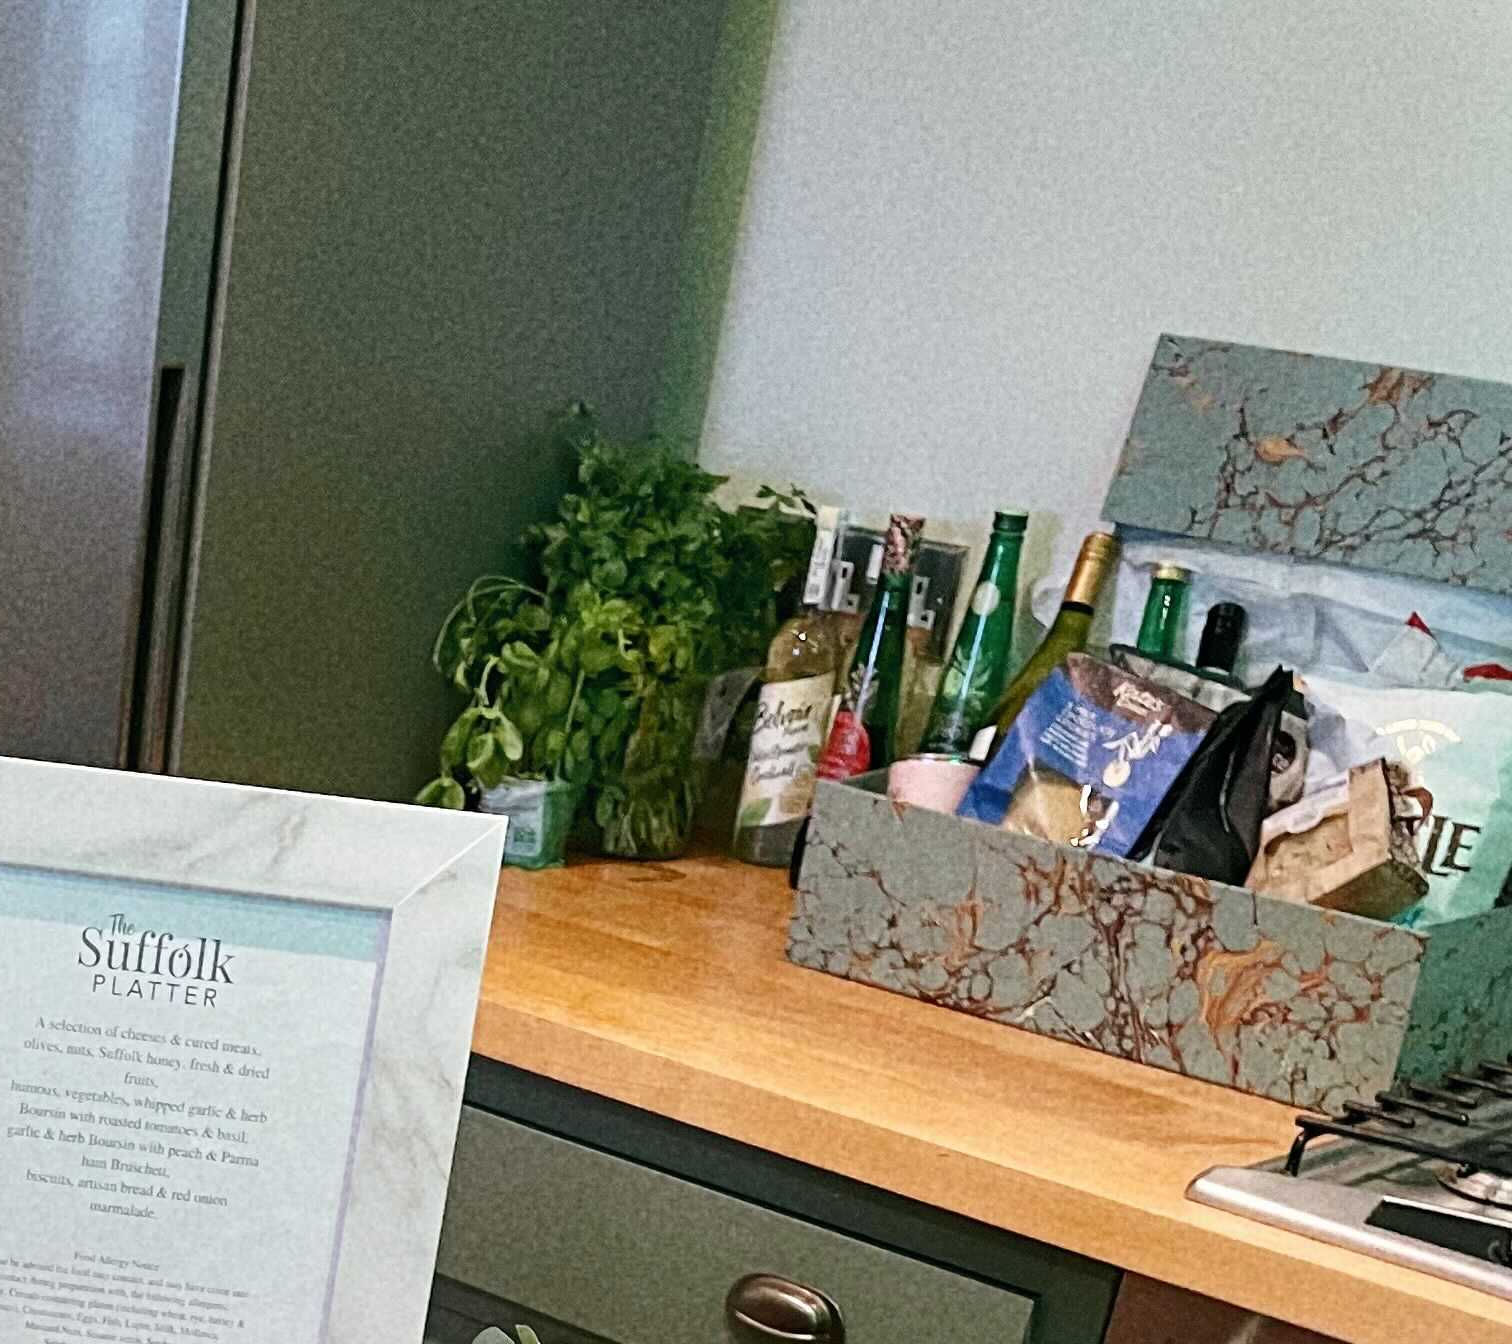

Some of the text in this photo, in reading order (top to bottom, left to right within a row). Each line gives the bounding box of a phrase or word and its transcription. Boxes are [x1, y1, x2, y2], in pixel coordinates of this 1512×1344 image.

[109, 912, 136, 937] The
[78, 926, 237, 985] Suffolk
[92, 973, 218, 1009] PLATTER
[35, 1016, 45, 1029] A
[49, 1019, 102, 1036] selection
[105, 1026, 120, 1038] of
[120, 1028, 167, 1044] cheeses
[171, 1034, 182, 1046] &
[184, 1038, 219, 1051] cured
[99, 1046, 143, 1063] Suffolk
[189, 1057, 220, 1073] fresh
[223, 1063, 234, 1075] &
[238, 1064, 270, 1080] dried
[19, 1102, 66, 1119] Boursin
[69, 1112, 95, 1124] with
[98, 1116, 142, 1130] roasted
[201, 1127, 214, 1139] &
[134, 1096, 186, 1115] whipped
[187, 1105, 223, 1118] garlic
[225, 1107, 237, 1120] &
[240, 1108, 268, 1124] herb
[7, 1125, 259, 1167] garlic & herb Boursin with peach & Parma
[77, 1179, 117, 1193] artisan
[120, 1181, 154, 1197] bread
[156, 1187, 167, 1199] &
[171, 1190, 191, 1202] red
[193, 1194, 228, 1207] onion
